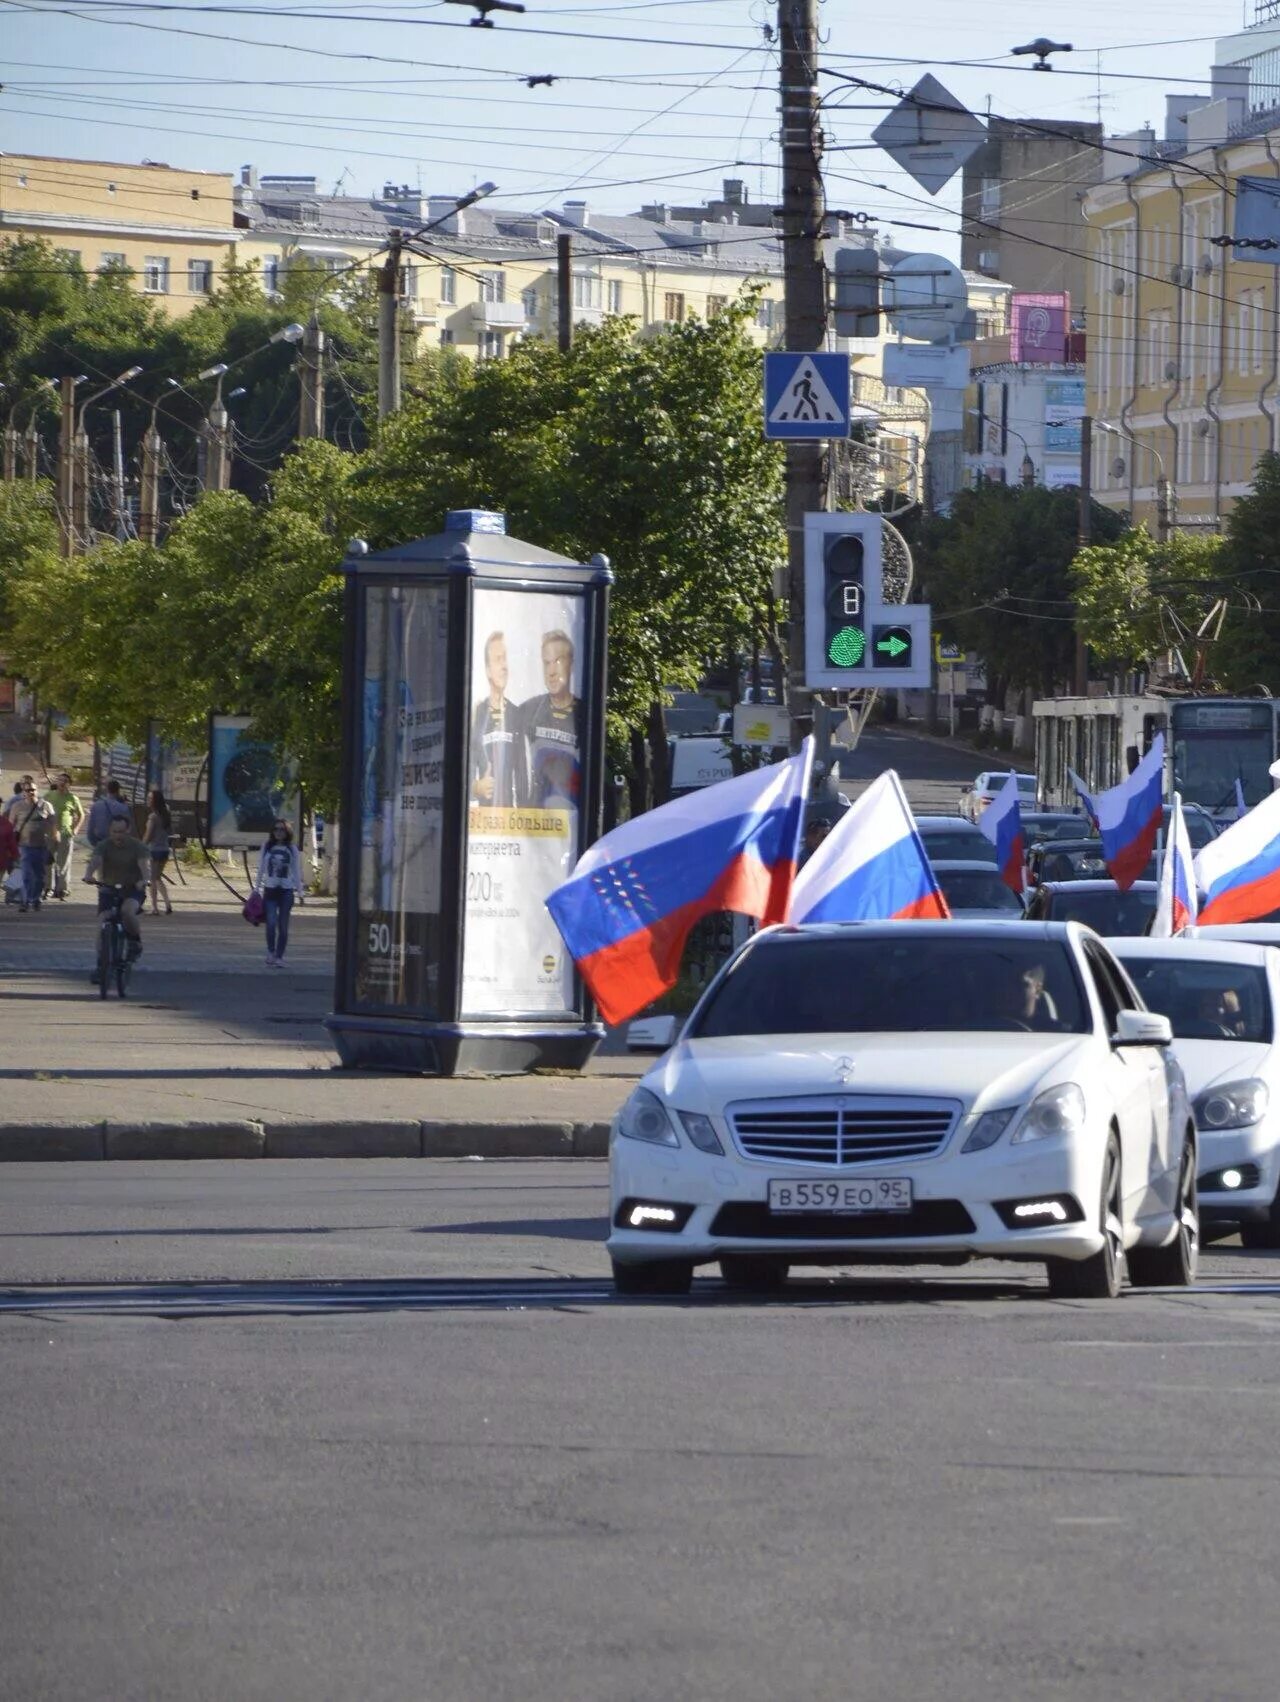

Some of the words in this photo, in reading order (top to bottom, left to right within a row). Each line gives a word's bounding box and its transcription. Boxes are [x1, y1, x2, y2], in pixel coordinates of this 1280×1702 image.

[843, 586, 859, 614] 8
[508, 811, 563, 832] больше
[879, 1181, 903, 1200] 95
